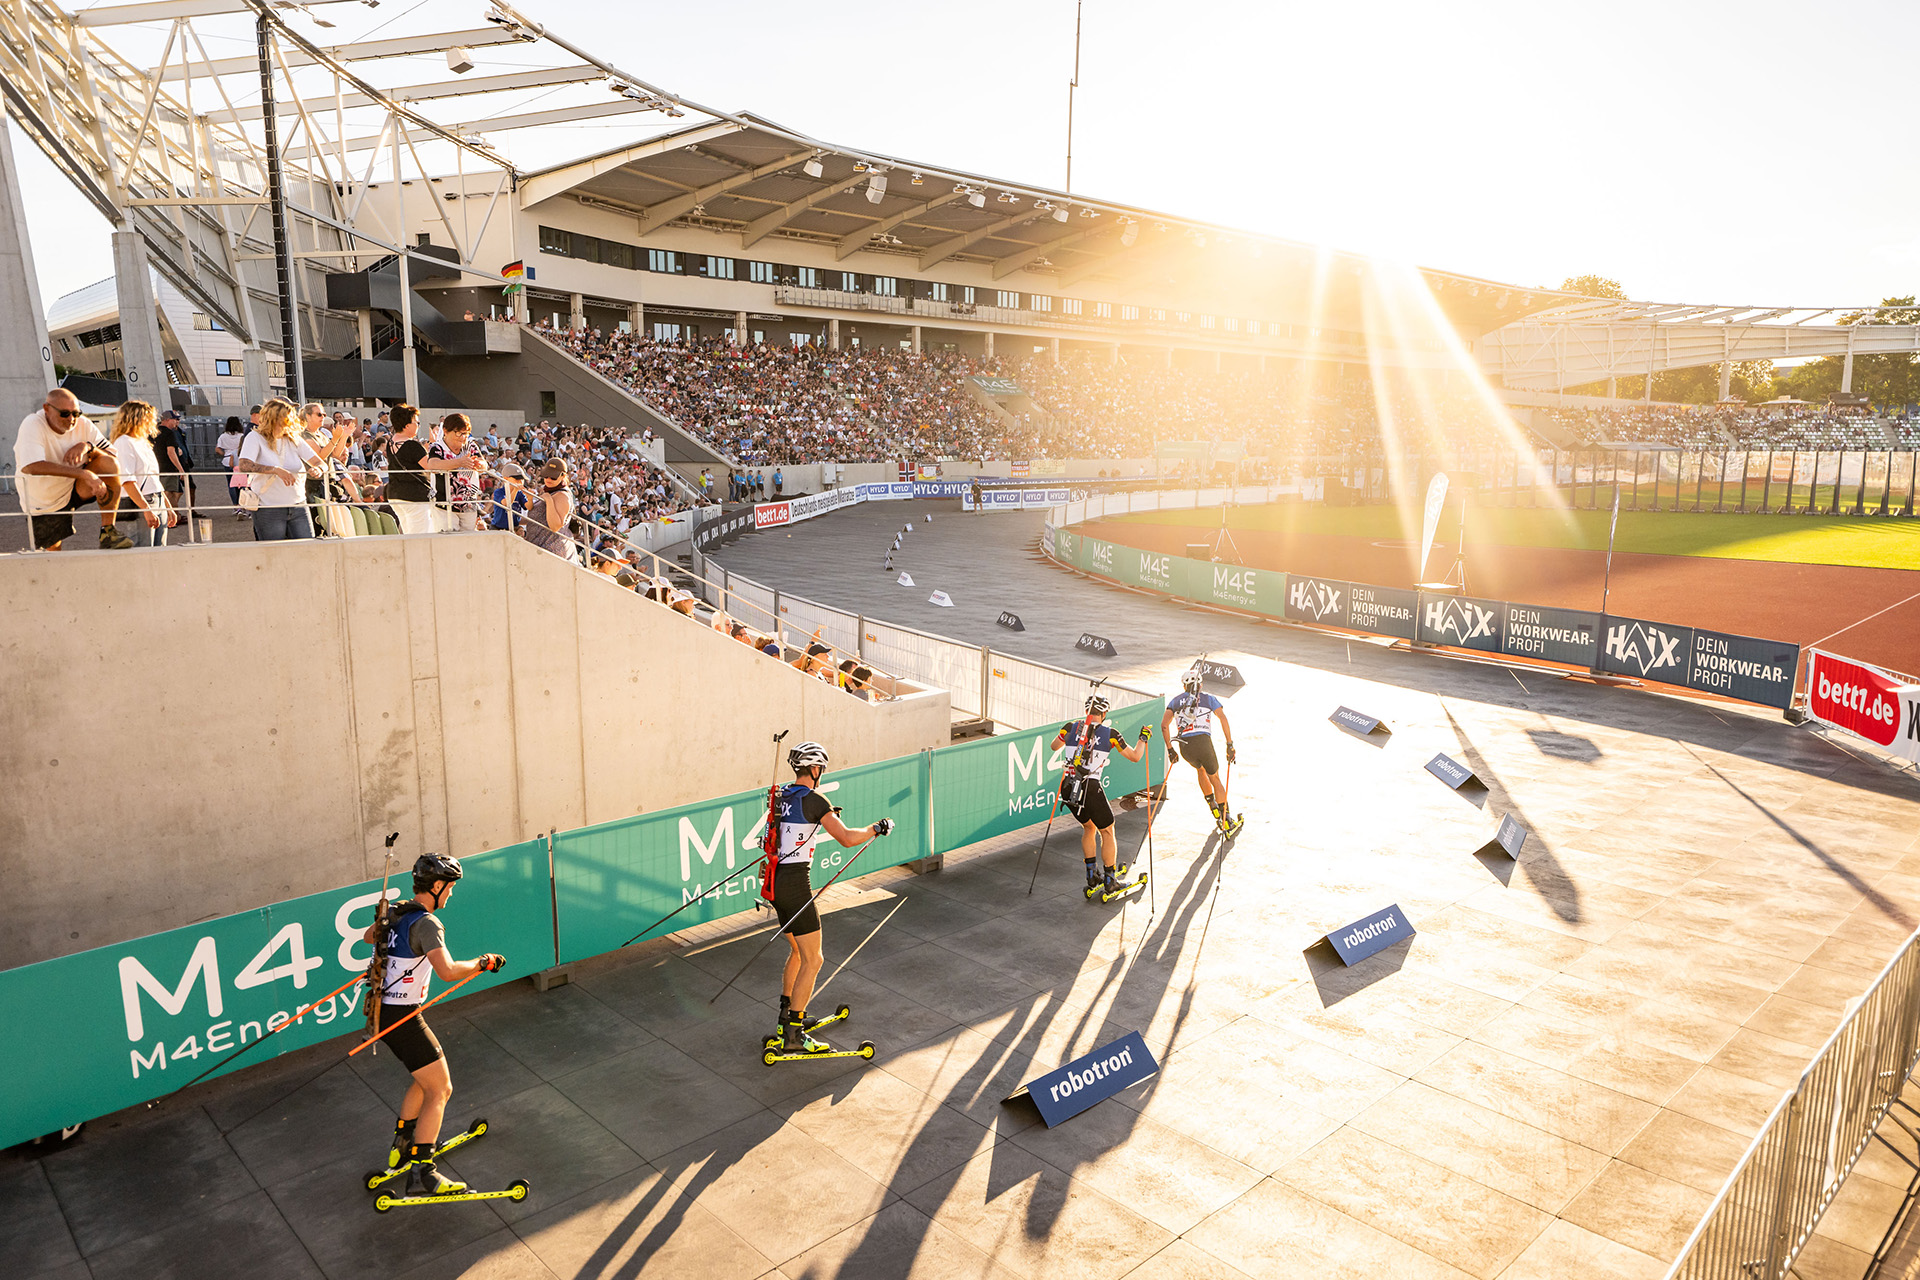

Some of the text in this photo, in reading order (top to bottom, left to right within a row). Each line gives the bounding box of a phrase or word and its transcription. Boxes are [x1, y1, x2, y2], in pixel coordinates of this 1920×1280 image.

[893, 485, 910, 493] HYLO
[913, 484, 938, 495] HYLO
[996, 493, 1015, 502] HYLO
[1026, 493, 1043, 501] HYLO
[1050, 491, 1065, 500] HYLO
[968, 494, 989, 503] HO
[757, 506, 788, 524] bett1.de
[1060, 532, 1072, 553] M4E
[1093, 541, 1113, 564] M4E
[1140, 552, 1170, 578] M4E
[1139, 573, 1165, 588] M4Energy
[1213, 566, 1257, 595] M4E
[1213, 589, 1249, 605] M4Energy
[1352, 588, 1374, 602] DEIN
[1352, 601, 1413, 620] WORKWEAR-
[1510, 608, 1540, 624] DEIN
[1351, 613, 1377, 628] PROFI
[1510, 624, 1595, 646] WORKWEAR-
[1508, 637, 1544, 653] PROFI
[1697, 636, 1728, 656] DEIN
[1696, 652, 1788, 682] WORKWEAR-
[1693, 668, 1732, 690] PROFI
[1818, 671, 1894, 726] bett1.de
[1338, 711, 1370, 727] robotron
[1434, 757, 1463, 780] robotron
[820, 851, 842, 869] eG
[1342, 915, 1395, 950] robotron
[118, 887, 401, 1043] M4E
[130, 986, 363, 1080] M4Energy
[1049, 1046, 1133, 1103] robotron
